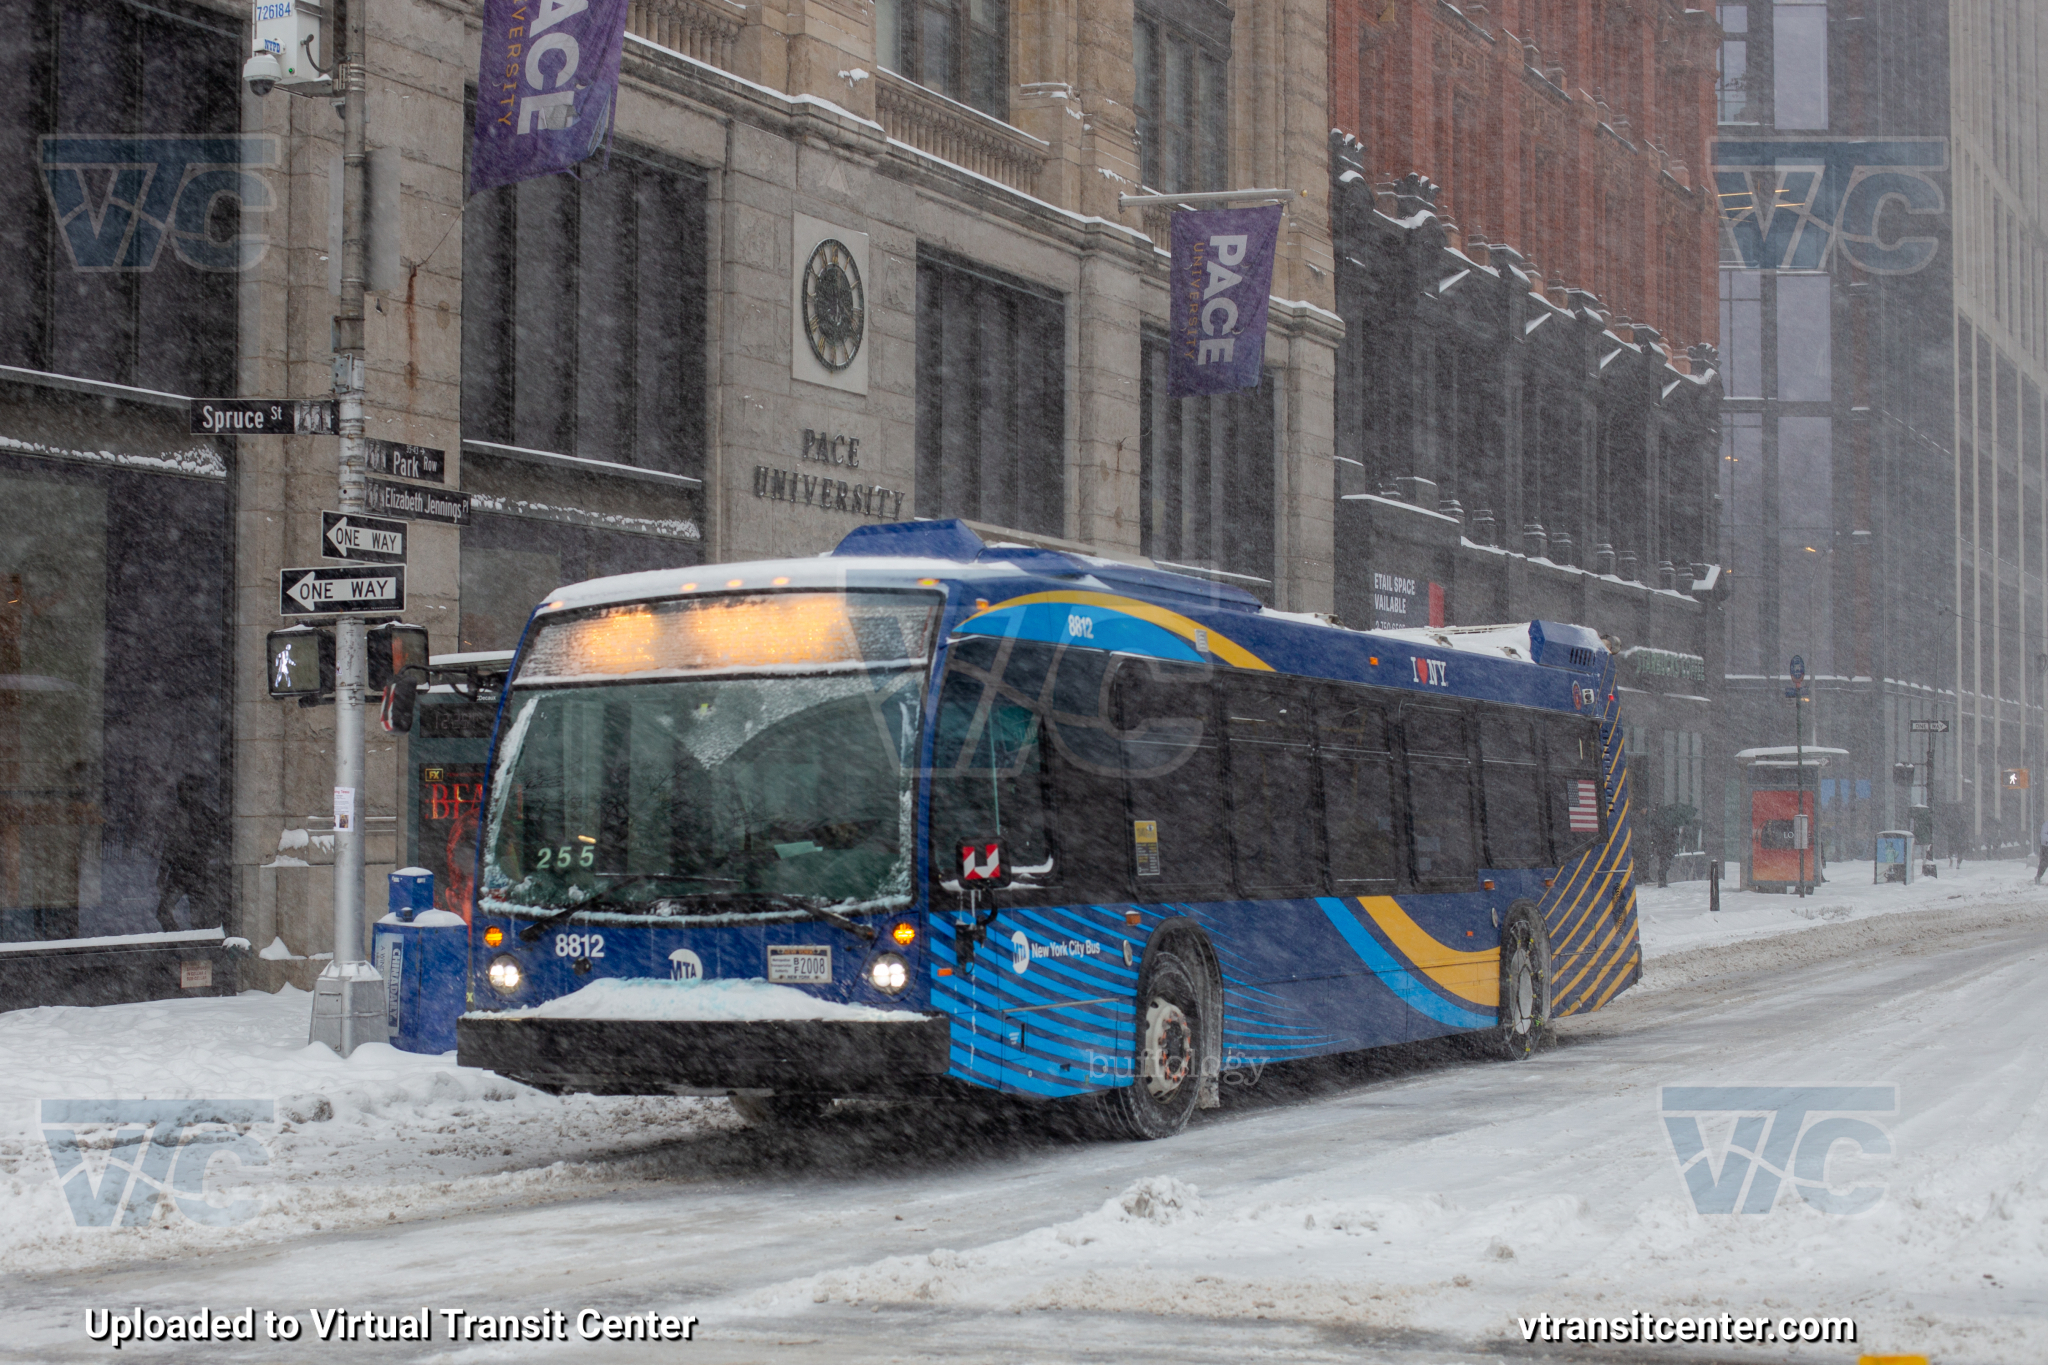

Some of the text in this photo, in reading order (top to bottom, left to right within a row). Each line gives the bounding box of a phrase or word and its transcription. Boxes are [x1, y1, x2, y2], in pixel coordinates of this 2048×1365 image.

[256, 2, 291, 21] 726184
[264, 39, 281, 53] NYPD
[498, 0, 527, 126] VERSITY
[517, 0, 589, 135] ACE
[1184, 242, 1205, 360] UNIVERSITY
[1198, 234, 1248, 366] PACE
[202, 405, 283, 433] Spruce St
[802, 428, 860, 468] PACE
[393, 451, 438, 478] Park Row
[385, 487, 469, 523] Elizabeth Jennings Pl
[754, 465, 906, 520] UNIVERSITY
[335, 527, 397, 552] ONE WAY
[300, 580, 388, 600] ONE WAY
[1374, 573, 1416, 596] ETAIL SPACE
[1374, 593, 1407, 614] VAILABLE
[1067, 614, 1095, 639] 8812
[1410, 656, 1447, 687] I NY
[428, 770, 440, 780] FX
[555, 934, 605, 958] 8812
[1031, 939, 1101, 958] New York City Bus
[670, 956, 699, 981] MTA
[800, 957, 825, 974] 2008
